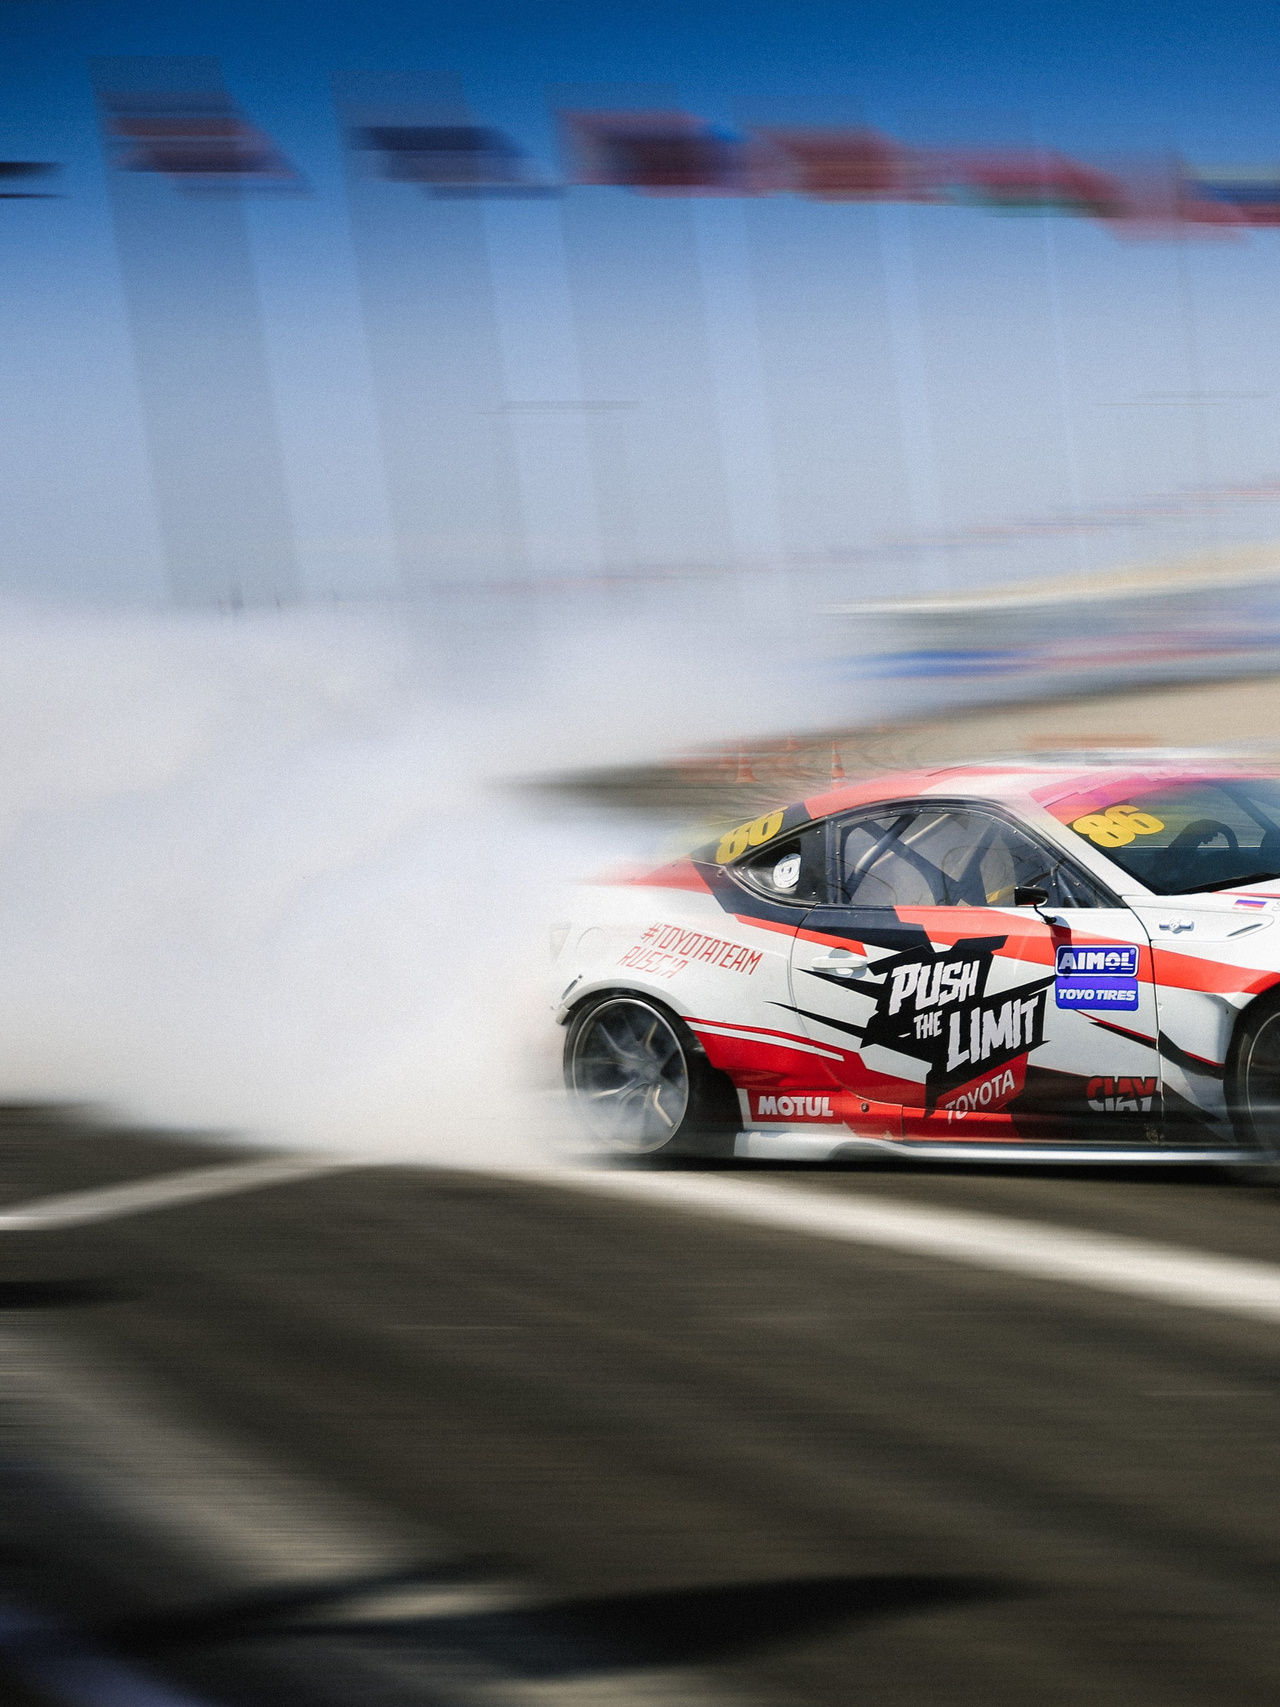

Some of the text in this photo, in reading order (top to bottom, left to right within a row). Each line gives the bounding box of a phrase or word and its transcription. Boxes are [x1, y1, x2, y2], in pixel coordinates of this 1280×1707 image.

[716, 806, 789, 864] 86
[1073, 805, 1165, 848] 86
[617, 946, 689, 979] RUSSIA
[640, 922, 763, 975] #TOYOTATEAM
[1059, 952, 1134, 970] AIMOL
[889, 960, 980, 1016] PUSH
[1058, 988, 1136, 1002] TOYO TIRES
[913, 1010, 943, 1040] THE
[946, 995, 1039, 1073] LIMIT
[758, 1095, 834, 1117] MOTUL
[944, 1069, 1016, 1125] TOYOTA
